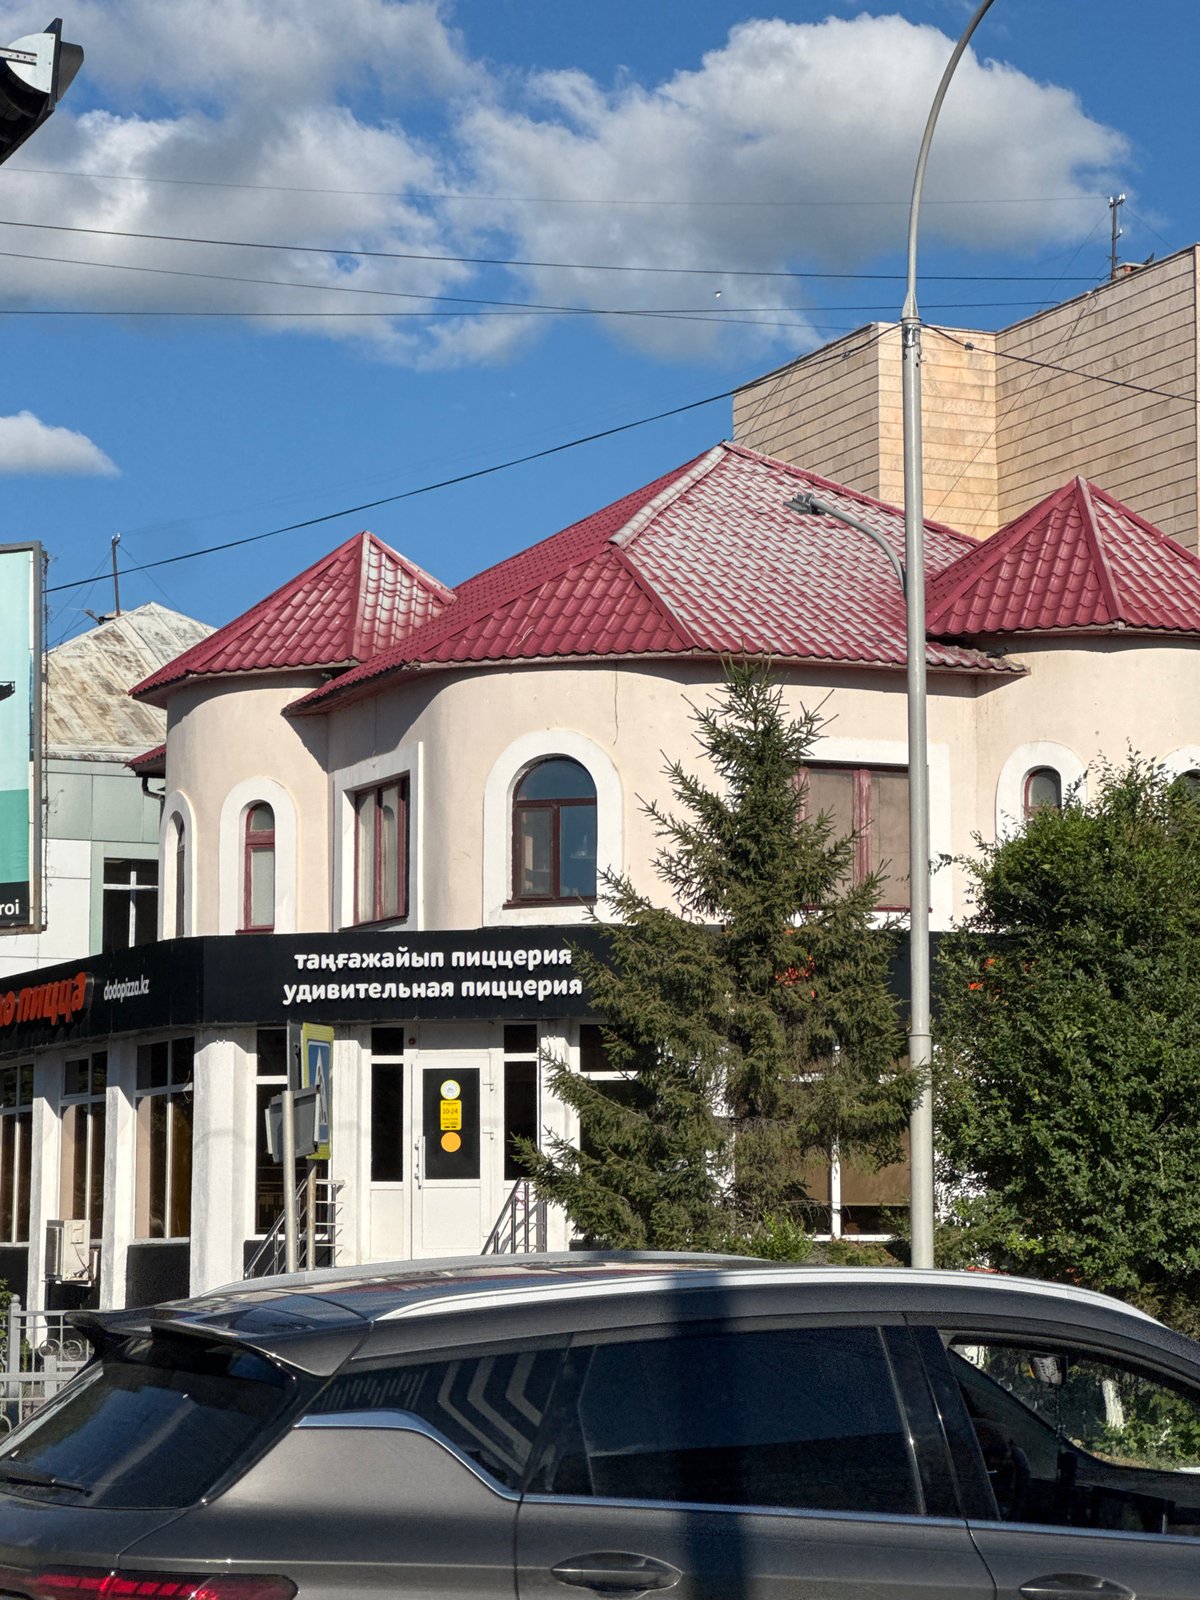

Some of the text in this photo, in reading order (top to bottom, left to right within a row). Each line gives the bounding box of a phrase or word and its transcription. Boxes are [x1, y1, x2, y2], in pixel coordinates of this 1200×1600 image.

[294, 946, 572, 972] таңғажайып пиццерия
[16, 971, 87, 1026] пицца
[103, 974, 150, 1003] dodopizza.kz
[282, 978, 583, 1006] удивительная пиццерия
